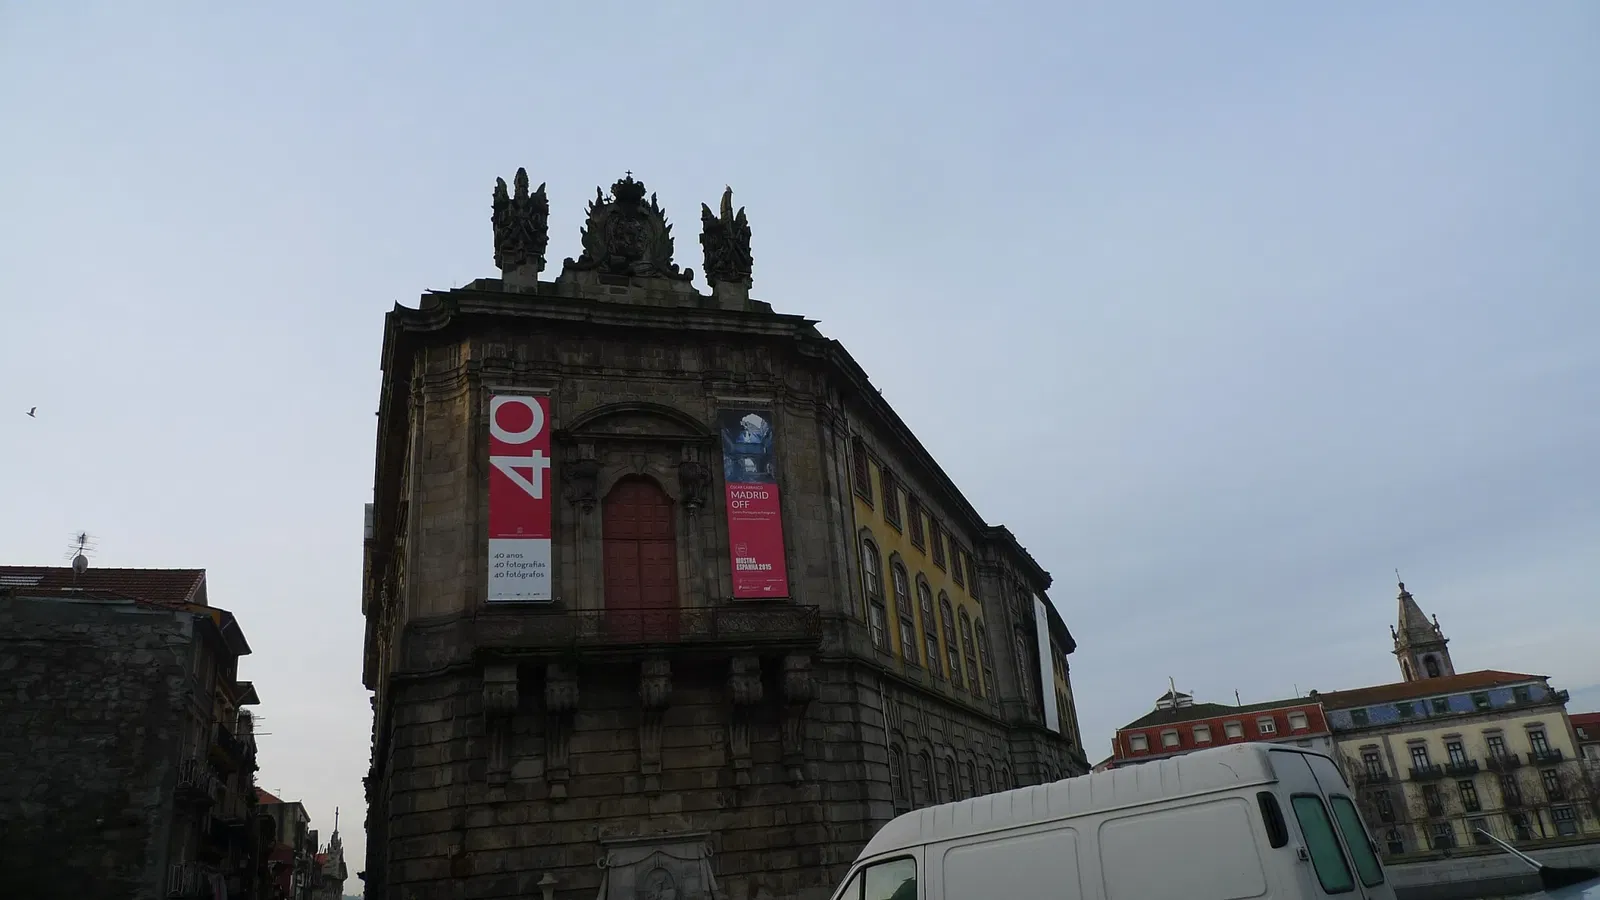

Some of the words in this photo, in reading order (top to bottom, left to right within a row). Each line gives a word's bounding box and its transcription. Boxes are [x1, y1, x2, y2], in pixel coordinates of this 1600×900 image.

[489, 395, 551, 499] 40
[731, 491, 769, 500] MADRID
[731, 501, 750, 509] OFF
[506, 561, 546, 569] fotografias
[506, 570, 545, 579] fotógrafos
